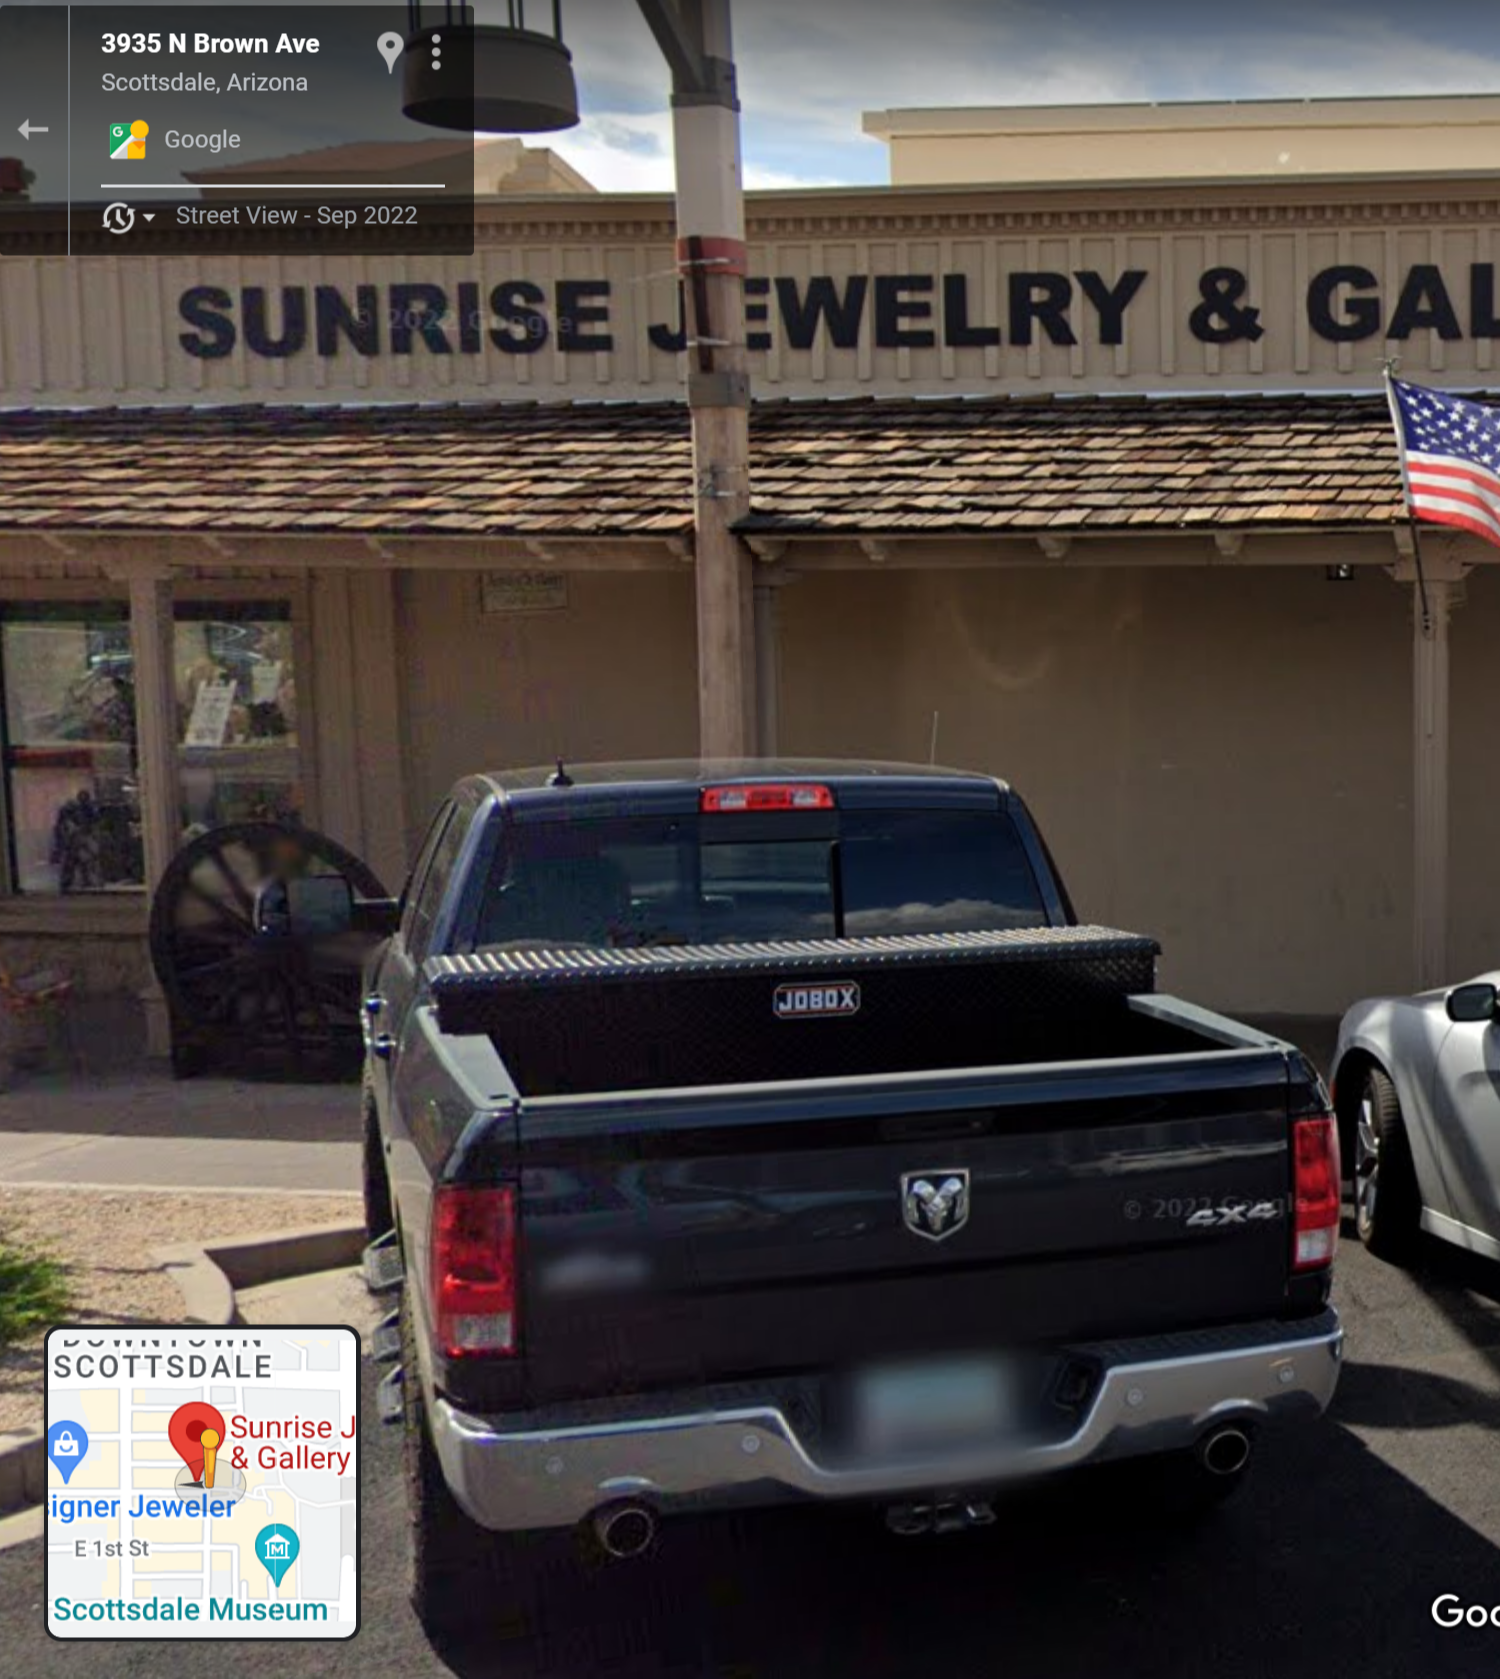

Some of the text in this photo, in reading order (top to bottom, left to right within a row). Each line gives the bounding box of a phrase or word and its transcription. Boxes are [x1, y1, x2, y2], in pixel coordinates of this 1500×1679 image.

[177, 279, 613, 359] SUNRISE
[1188, 267, 1264, 343] &
[778, 986, 855, 1012] JOBOX
